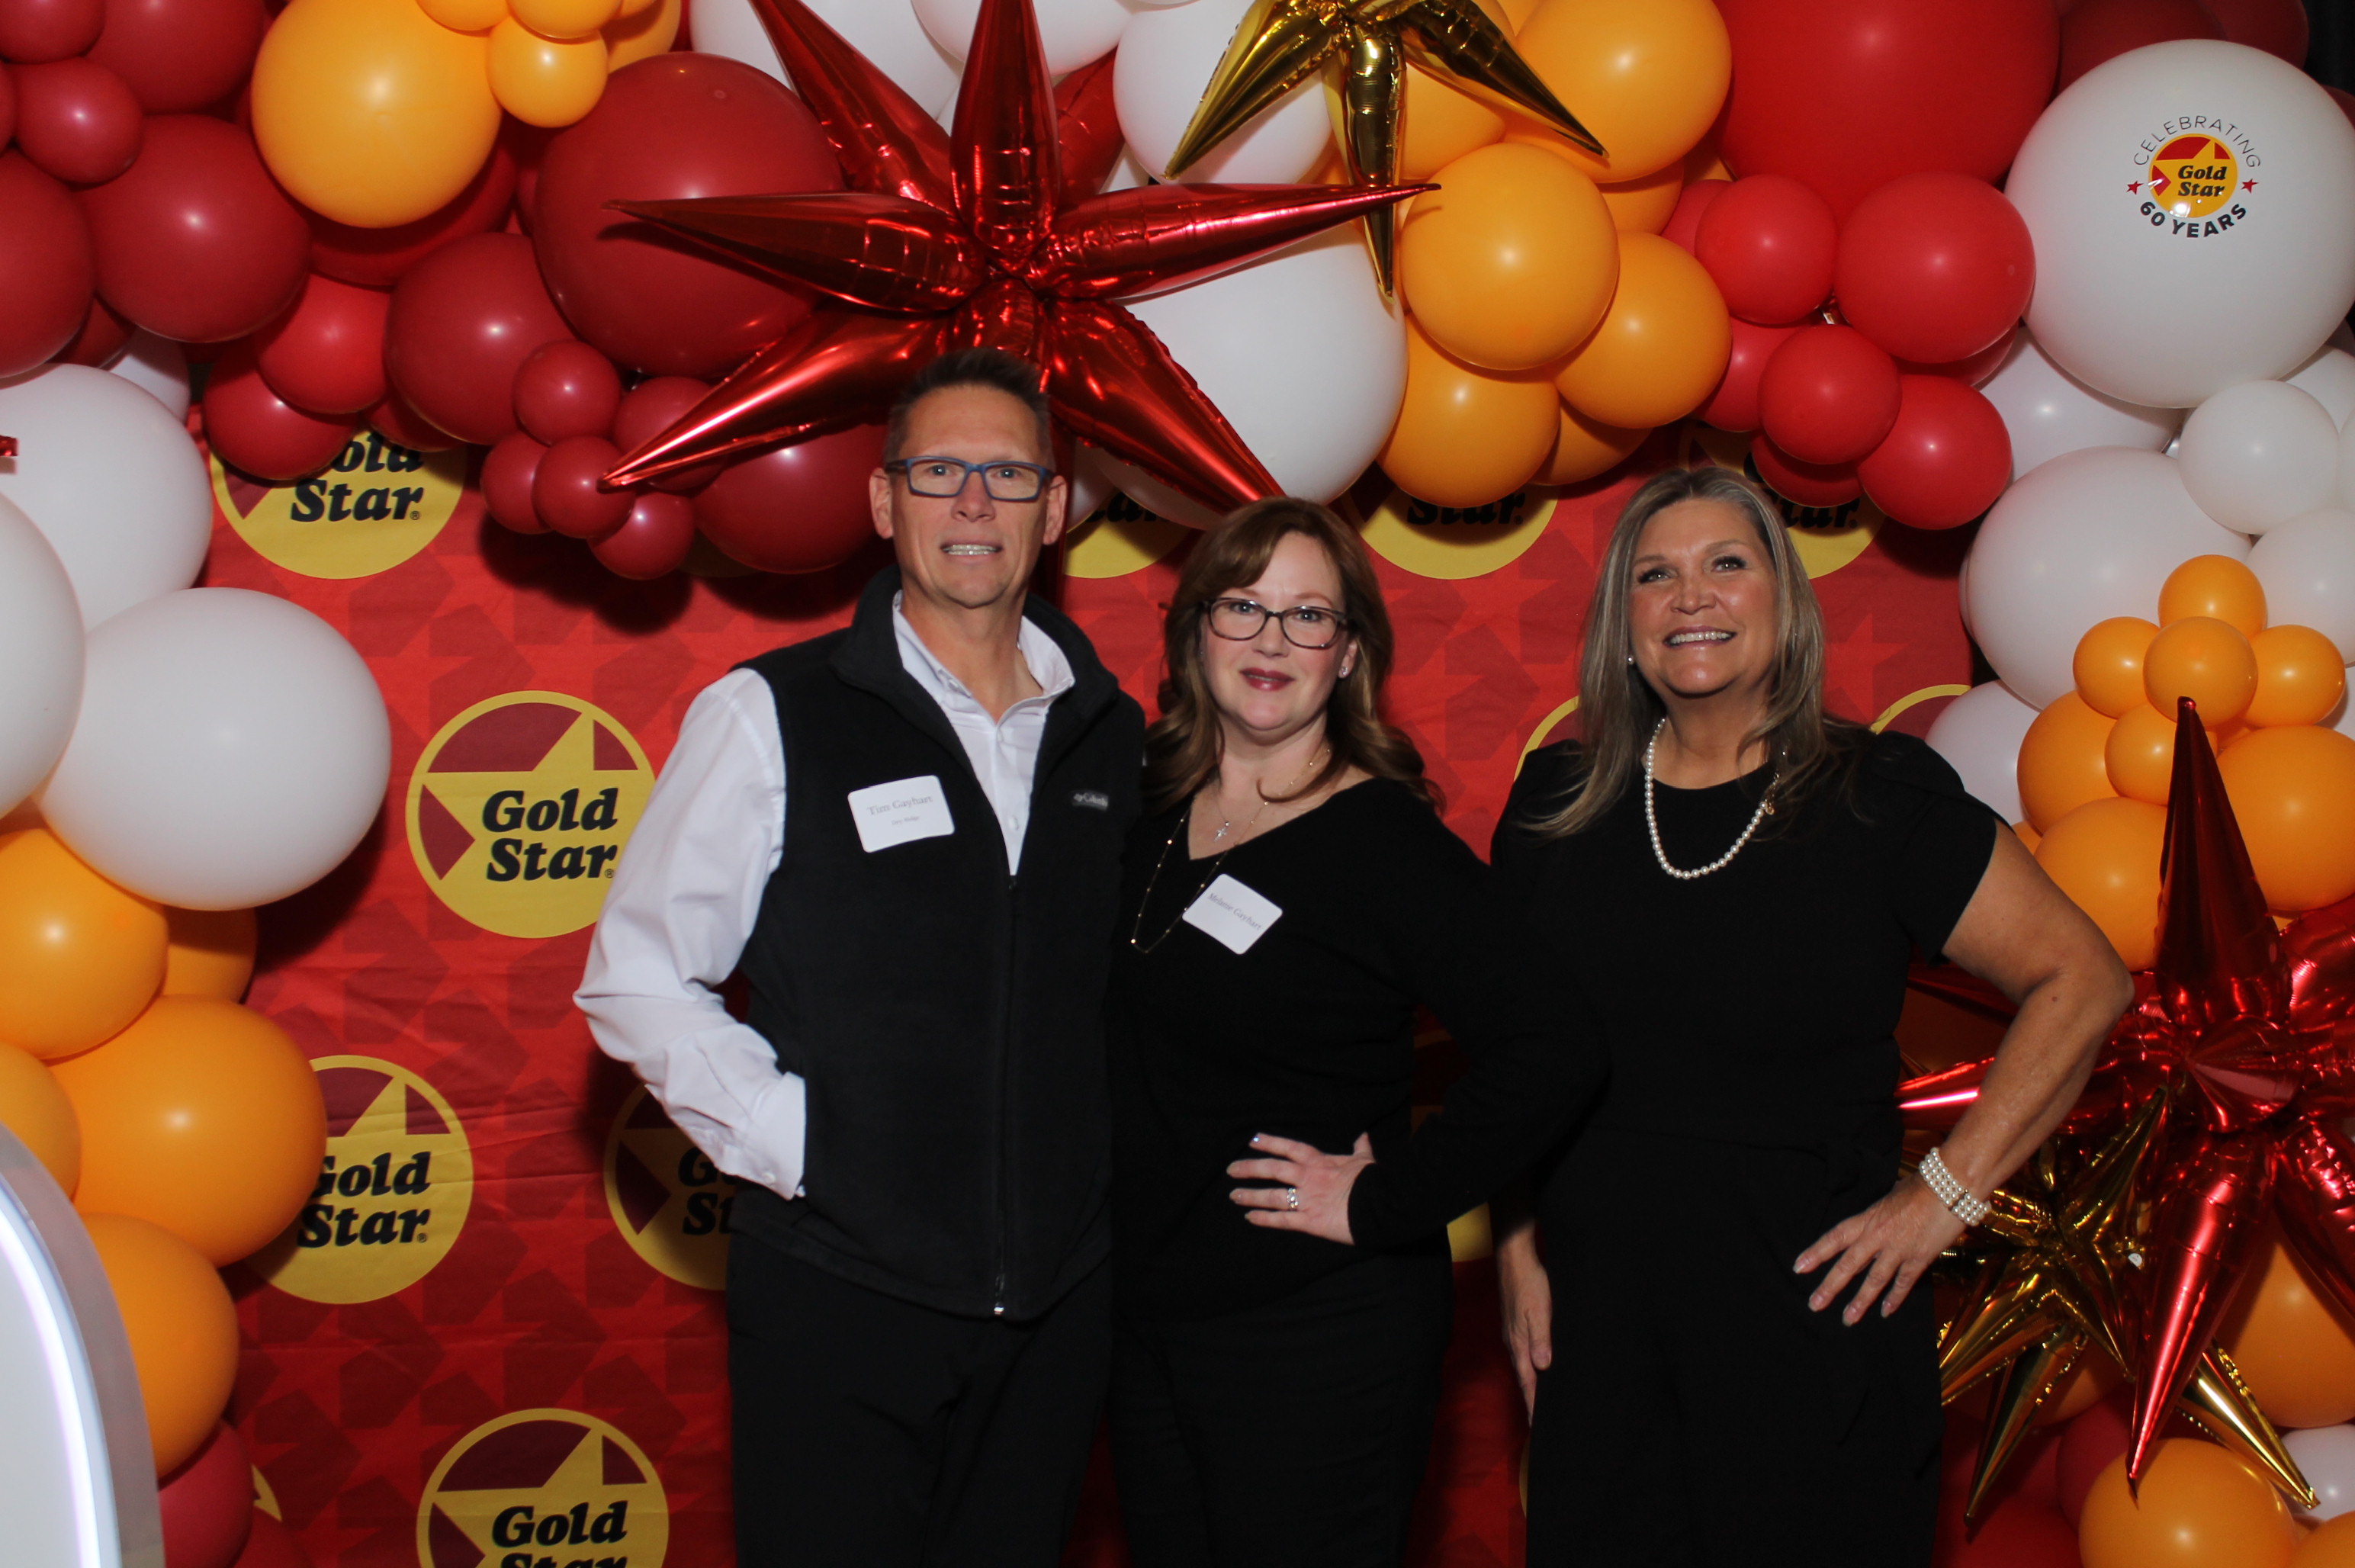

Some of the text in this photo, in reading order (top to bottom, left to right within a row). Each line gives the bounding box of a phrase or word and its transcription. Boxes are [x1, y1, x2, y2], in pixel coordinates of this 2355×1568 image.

[2134, 116, 2261, 168] CELEBRATING
[2178, 165, 2227, 180] Gold
[2178, 182, 2225, 197] Star
[2140, 201, 2246, 238] 60 YEARS
[331, 432, 423, 473] old
[482, 788, 618, 832] Gold
[866, 795, 933, 816] Tim Gayhart
[492, 1500, 628, 1547] Gold
